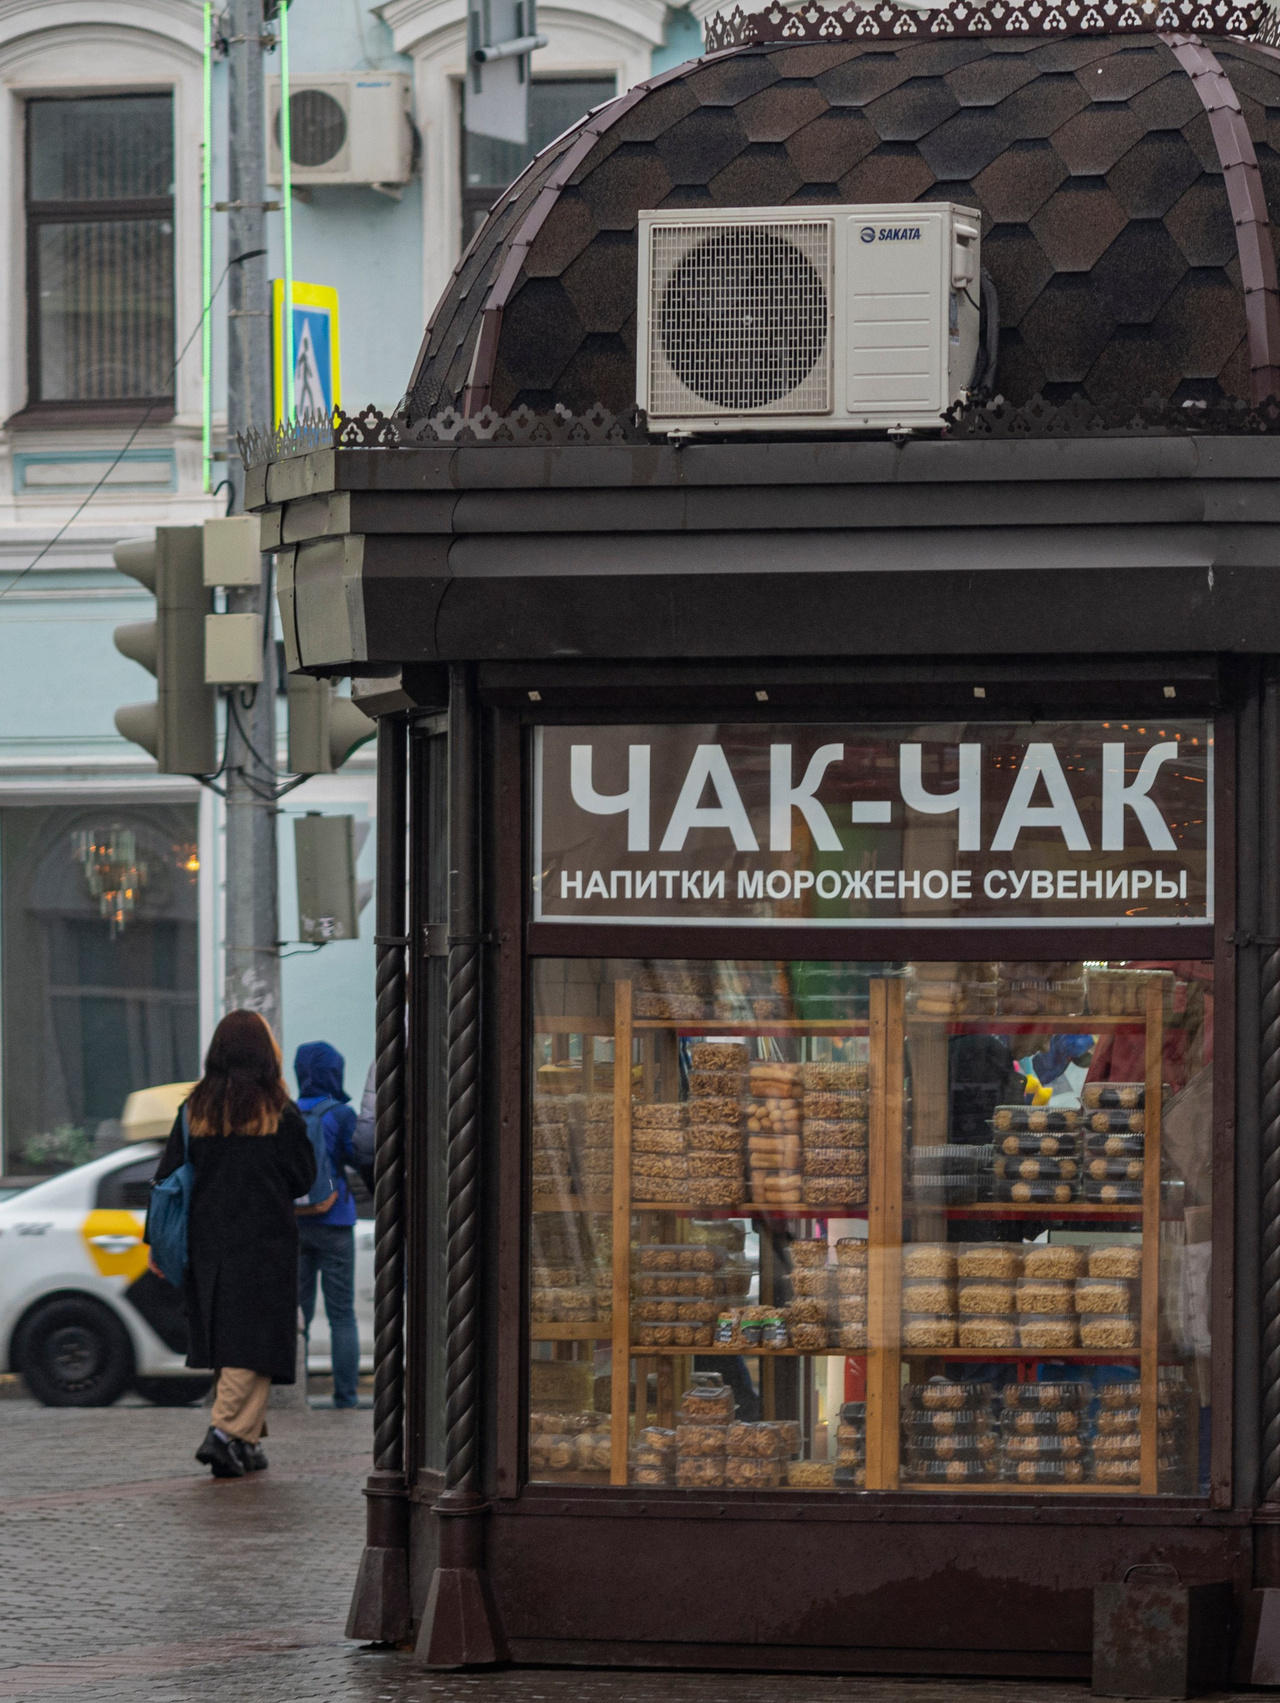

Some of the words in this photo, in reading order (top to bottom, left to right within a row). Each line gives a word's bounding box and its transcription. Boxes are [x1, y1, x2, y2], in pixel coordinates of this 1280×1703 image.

[878, 228, 921, 241] SAKATA
[570, 742, 1179, 852] ЧАК-ЧАК
[560, 870, 726, 899] НАПИТКИ
[737, 869, 973, 899] МОРОЖЕНОЕ
[983, 869, 1188, 899] СУВЕНИРЫ
